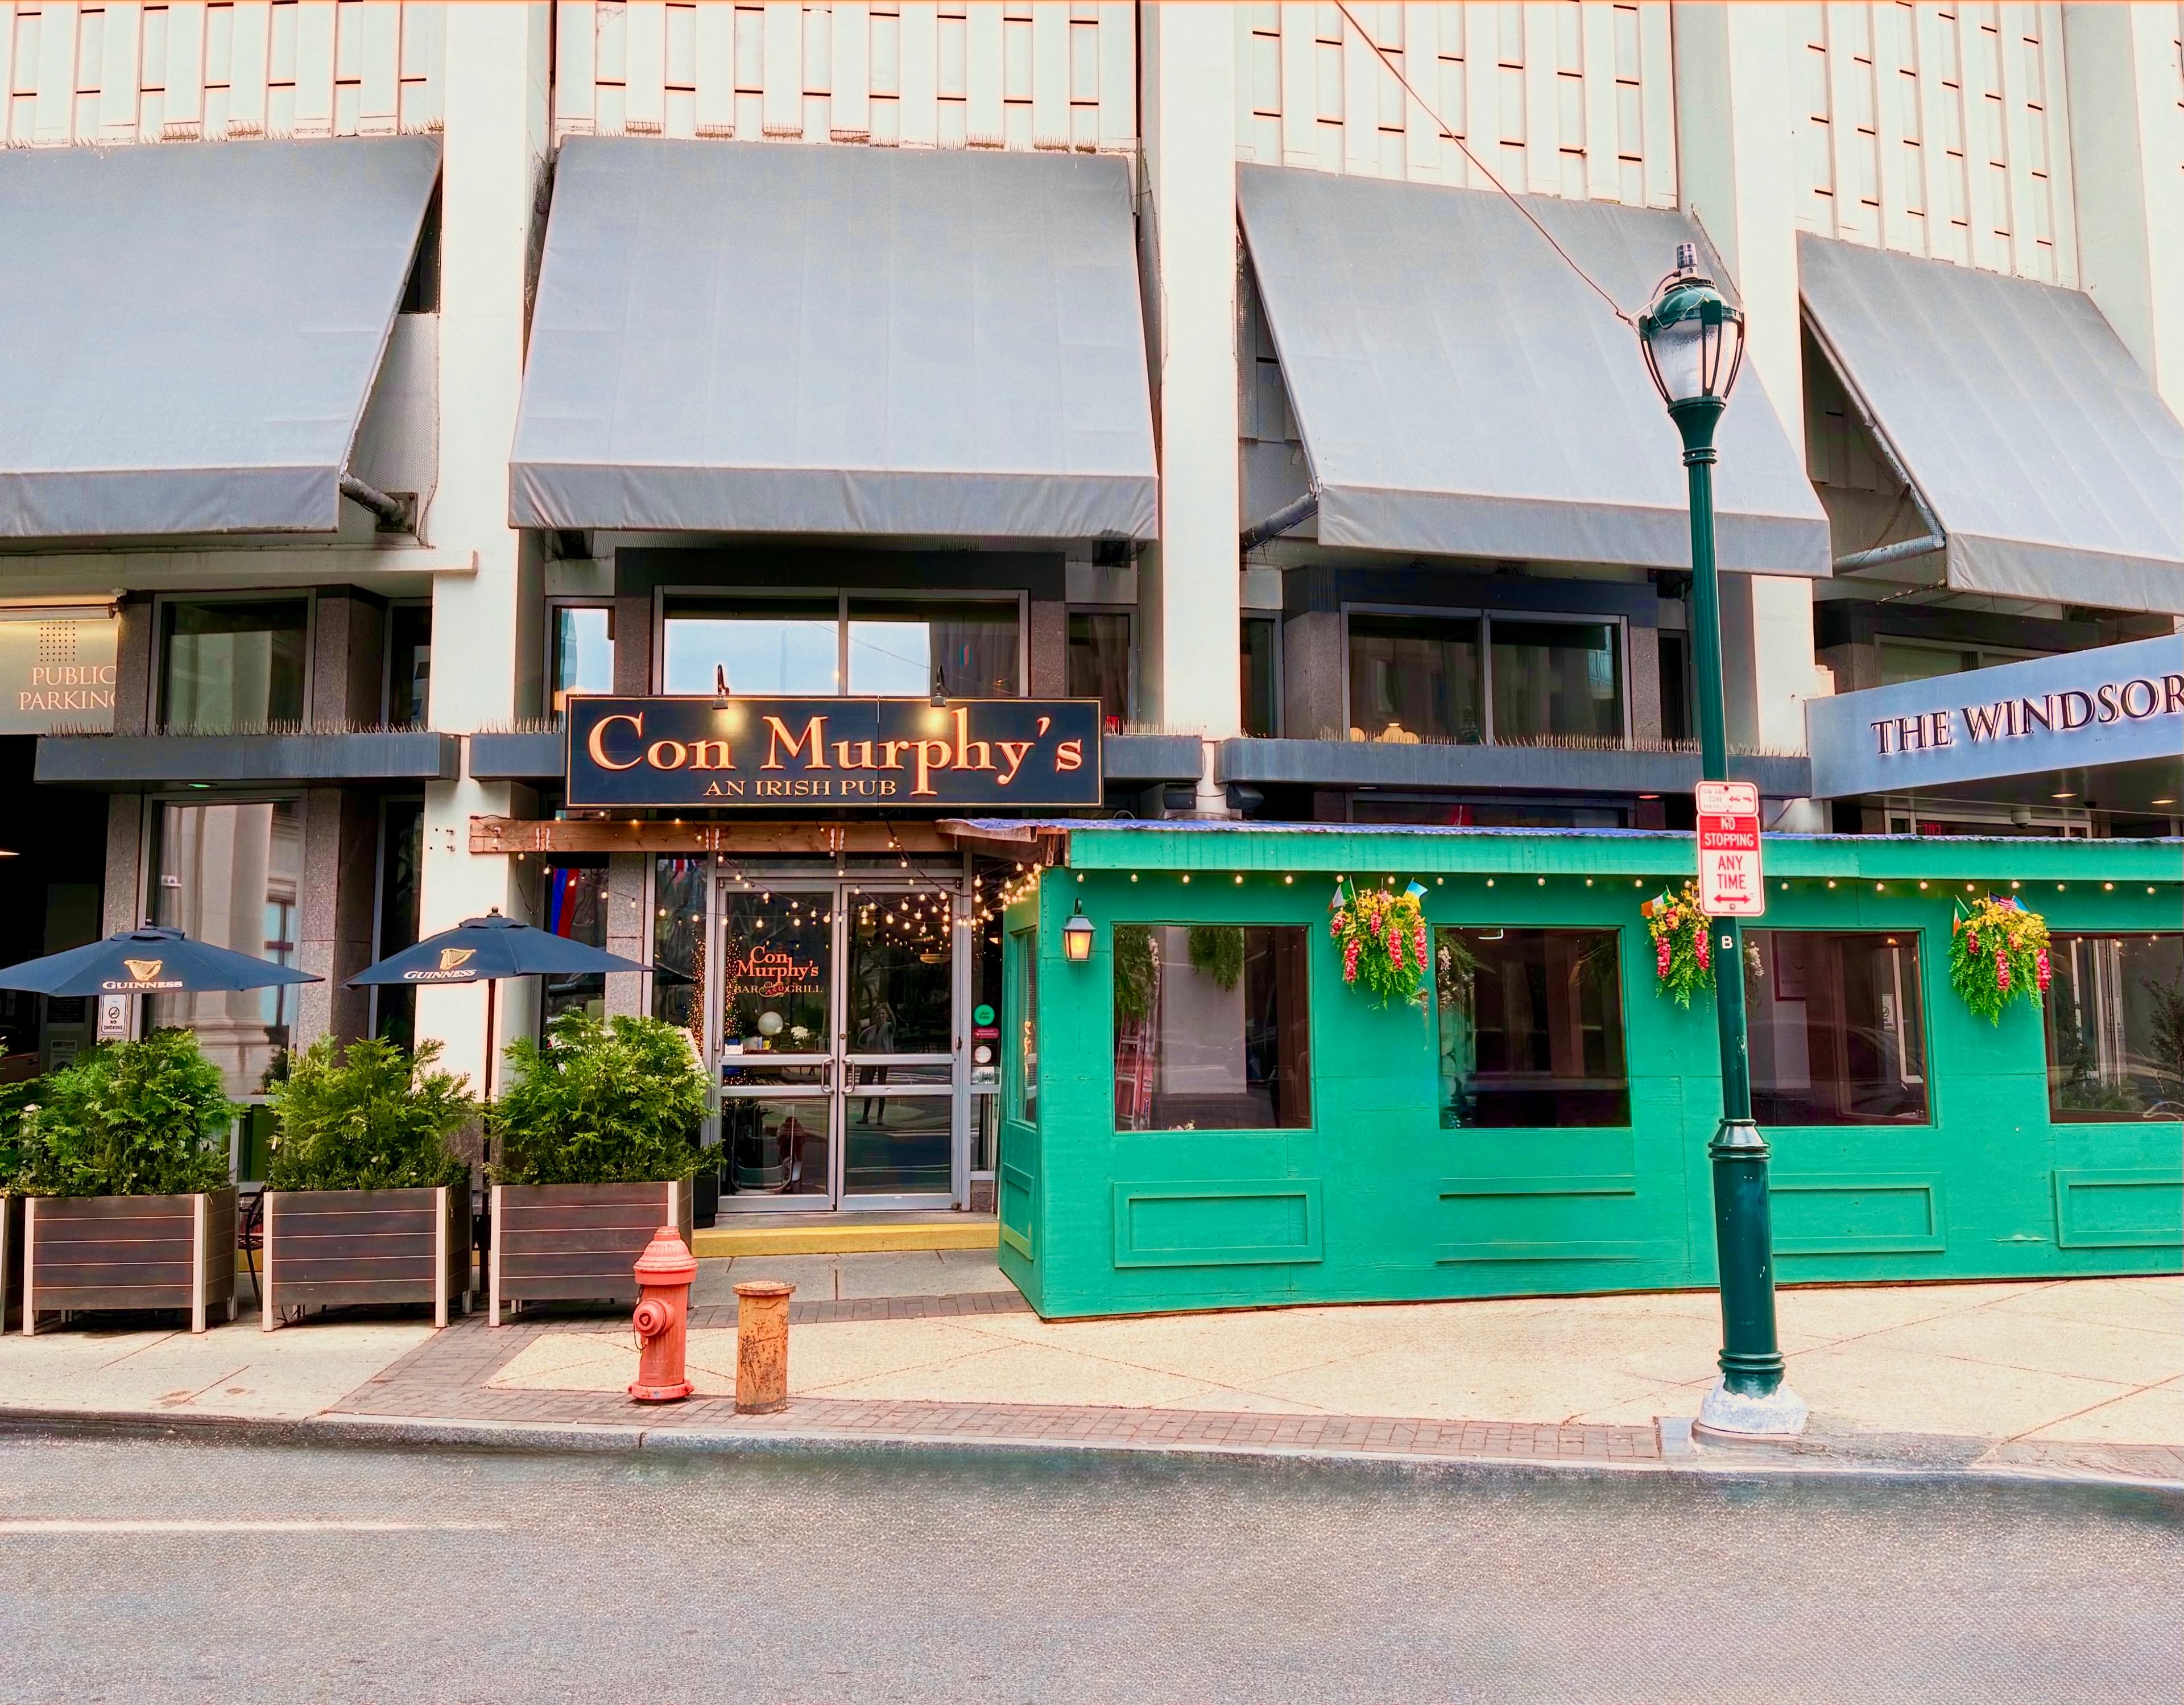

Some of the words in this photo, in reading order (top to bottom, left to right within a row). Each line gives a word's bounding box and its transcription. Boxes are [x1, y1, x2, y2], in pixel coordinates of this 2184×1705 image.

[32, 666, 117, 686] PUBLIC
[1870, 710, 1953, 755] THE
[1960, 674, 2184, 742] WINDSOR
[589, 711, 737, 770] Con
[761, 707, 1083, 796] Murphy's
[703, 780, 744, 796] AN
[755, 780, 832, 796] IRISH
[840, 780, 897, 796] PUB
[1720, 817, 1736, 830] NO
[1705, 833, 1754, 847] STOPPING
[1718, 855, 1743, 870] ANY
[1716, 874, 1747, 889] TIME
[1722, 936, 1733, 949] B
[750, 946, 788, 964] Con
[403, 969, 477, 979] GUINNESS
[736, 957, 819, 984] Murphy's
[102, 981, 183, 989] GUINNESS
[766, 986, 785, 995] AND
[786, 985, 823, 993] GRILL
